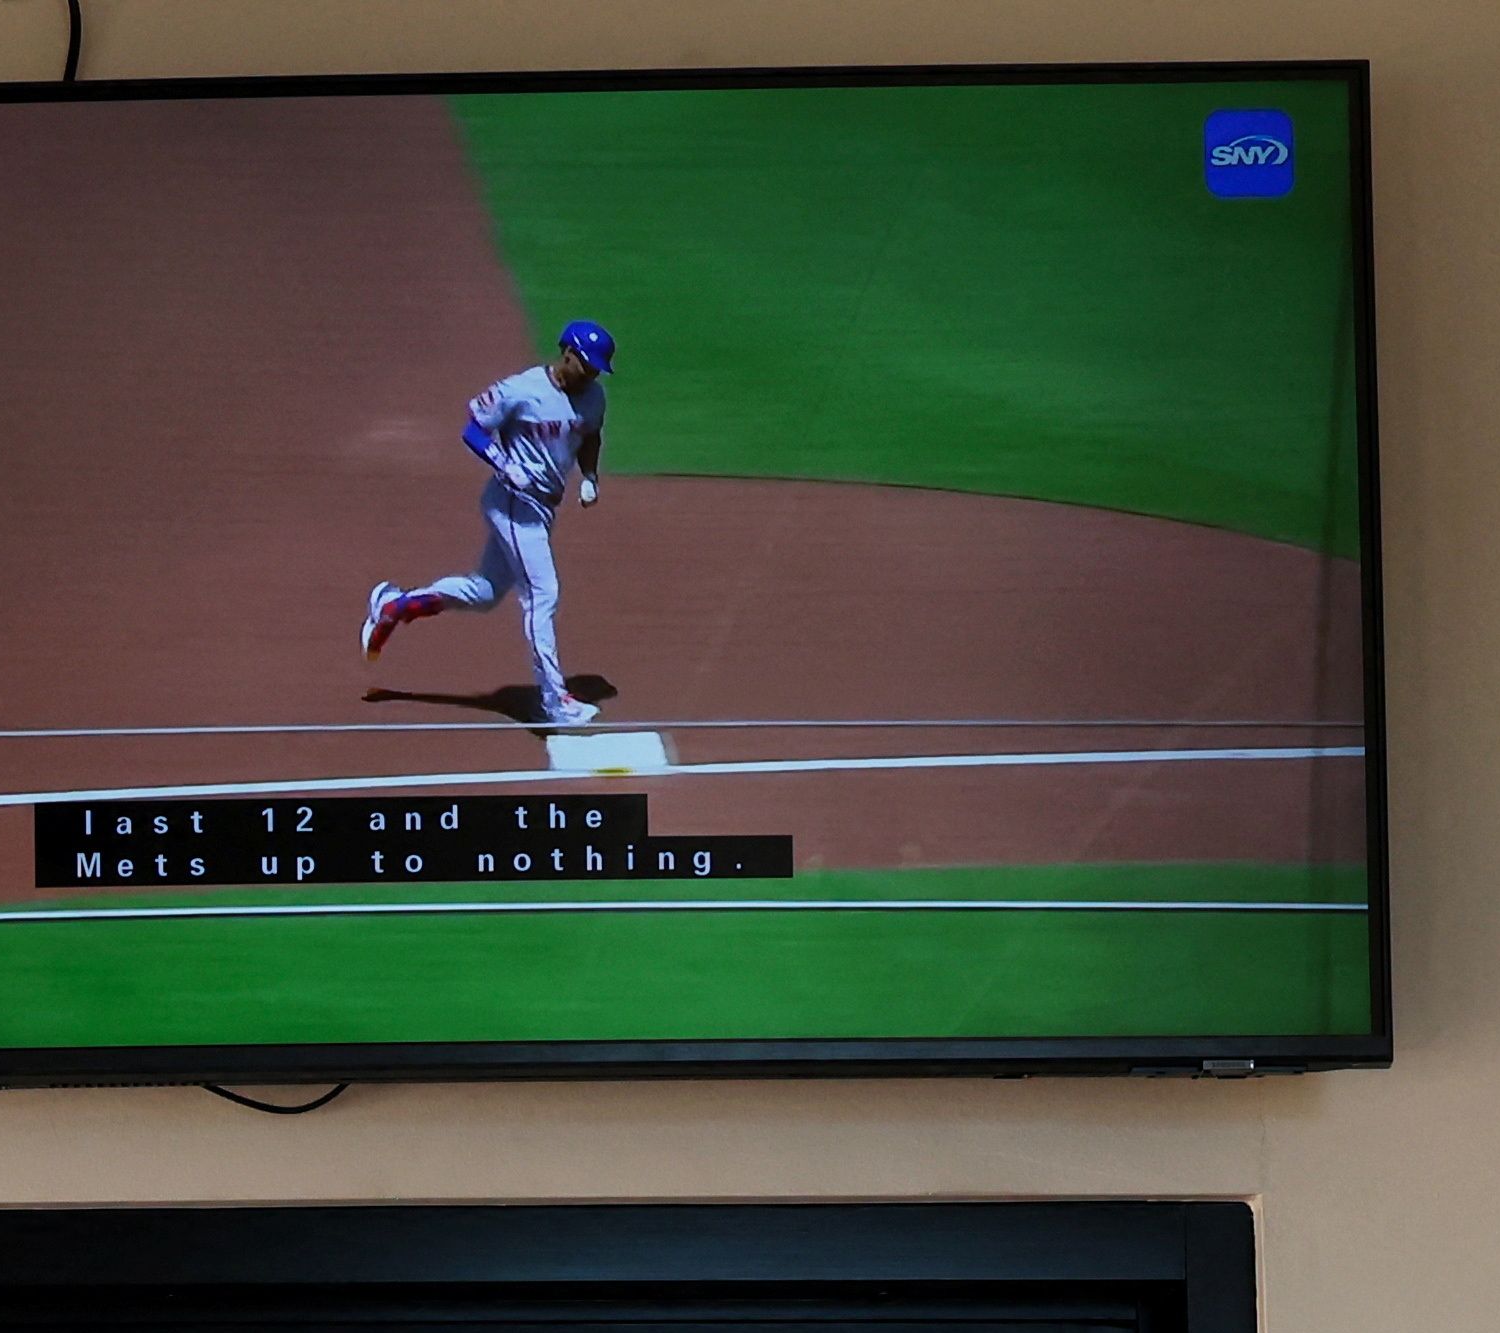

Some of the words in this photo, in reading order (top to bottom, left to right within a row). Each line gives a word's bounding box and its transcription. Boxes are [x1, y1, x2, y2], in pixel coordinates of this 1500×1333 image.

[1210, 146, 1276, 167] SNY
[85, 809, 204, 835] last
[261, 806, 314, 833] 12
[369, 804, 459, 831] and
[514, 803, 603, 829] the
[76, 852, 206, 878] Mets
[261, 855, 315, 880] up
[371, 851, 424, 874] to
[478, 845, 743, 876] nothing.
